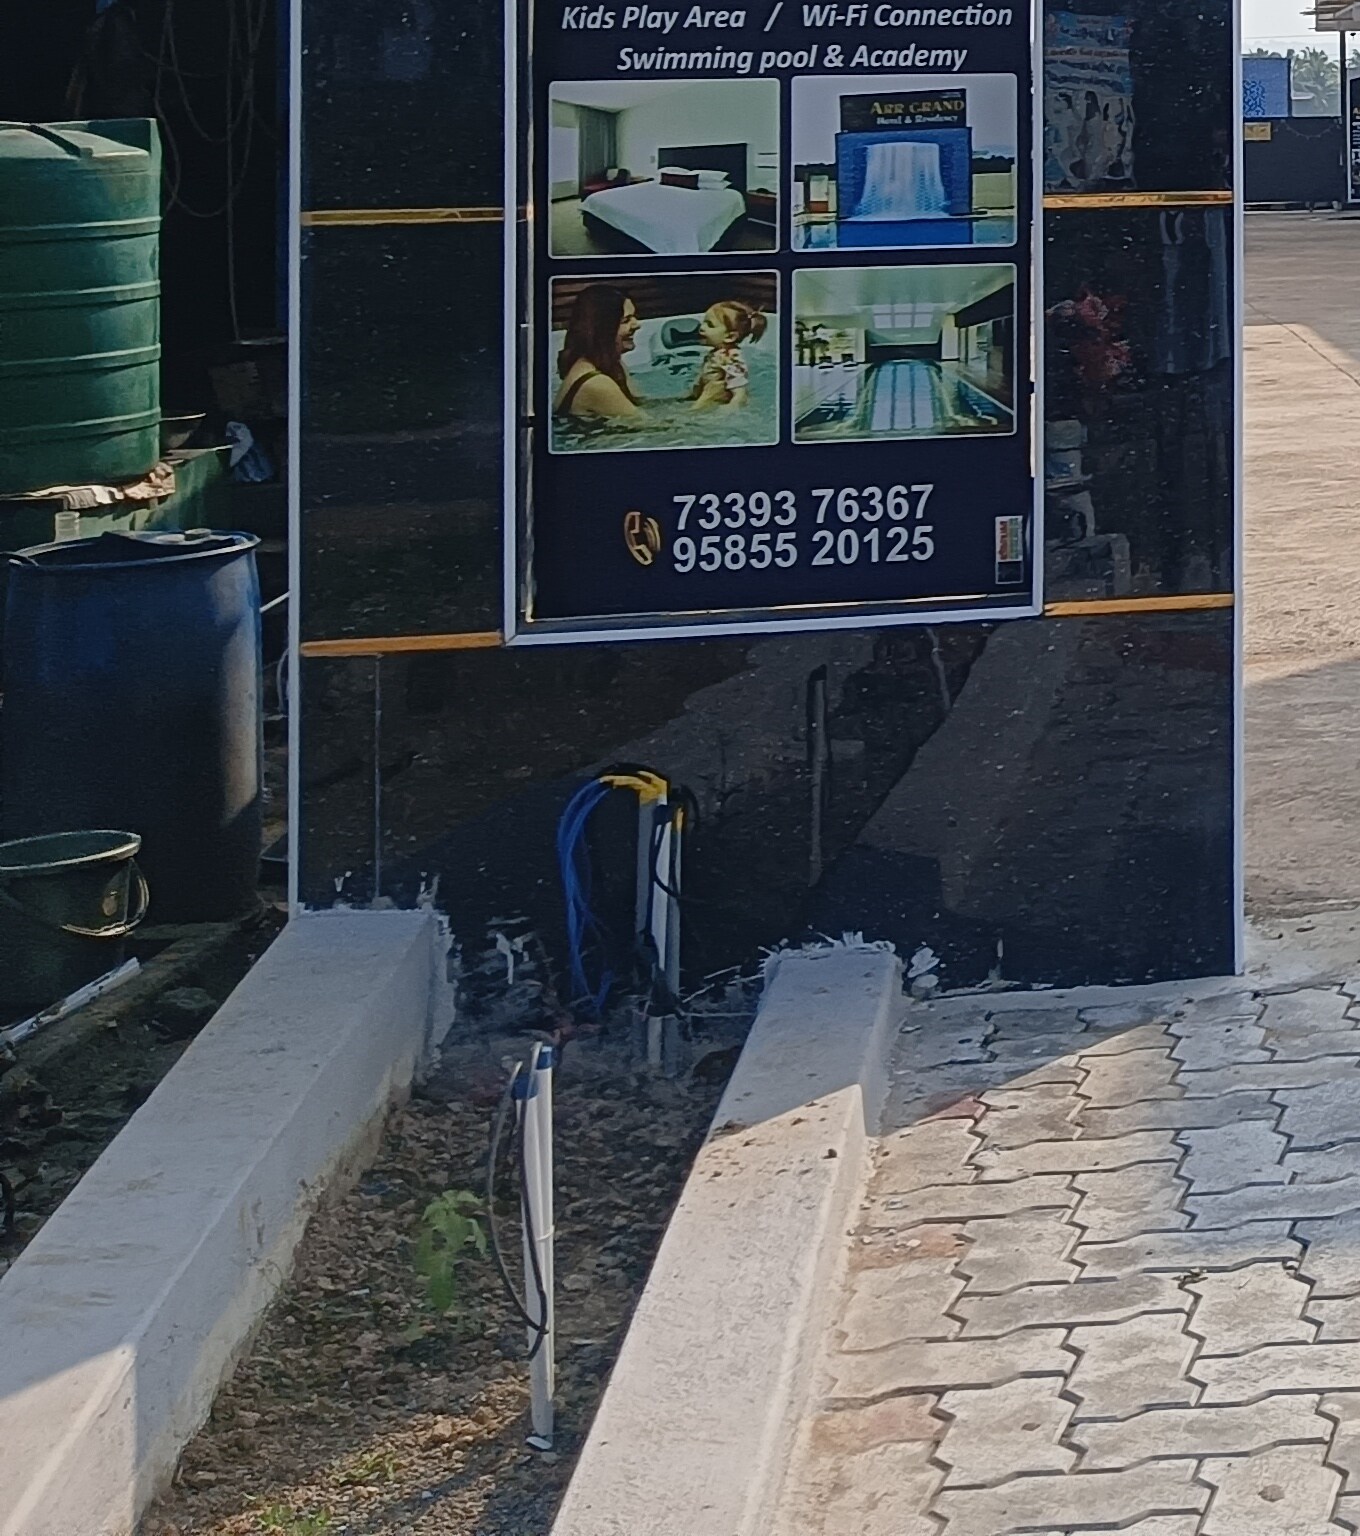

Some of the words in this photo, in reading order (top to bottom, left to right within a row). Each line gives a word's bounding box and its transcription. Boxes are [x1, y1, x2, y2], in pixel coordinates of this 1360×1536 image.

[562, 5, 615, 30] Kids
[622, 5, 680, 33] Play
[684, 5, 747, 28] Area
[764, 2, 785, 32] /
[802, 4, 868, 27] Wi-Fi
[873, 3, 1014, 26] Connection
[617, 47, 753, 73] Swimming
[759, 45, 817, 73] pool
[822, 46, 845, 68] &
[850, 43, 968, 70] Academy
[673, 490, 797, 531] 73393
[811, 484, 934, 523] 76367
[673, 531, 797, 573] 95855
[811, 525, 934, 566] 20125
